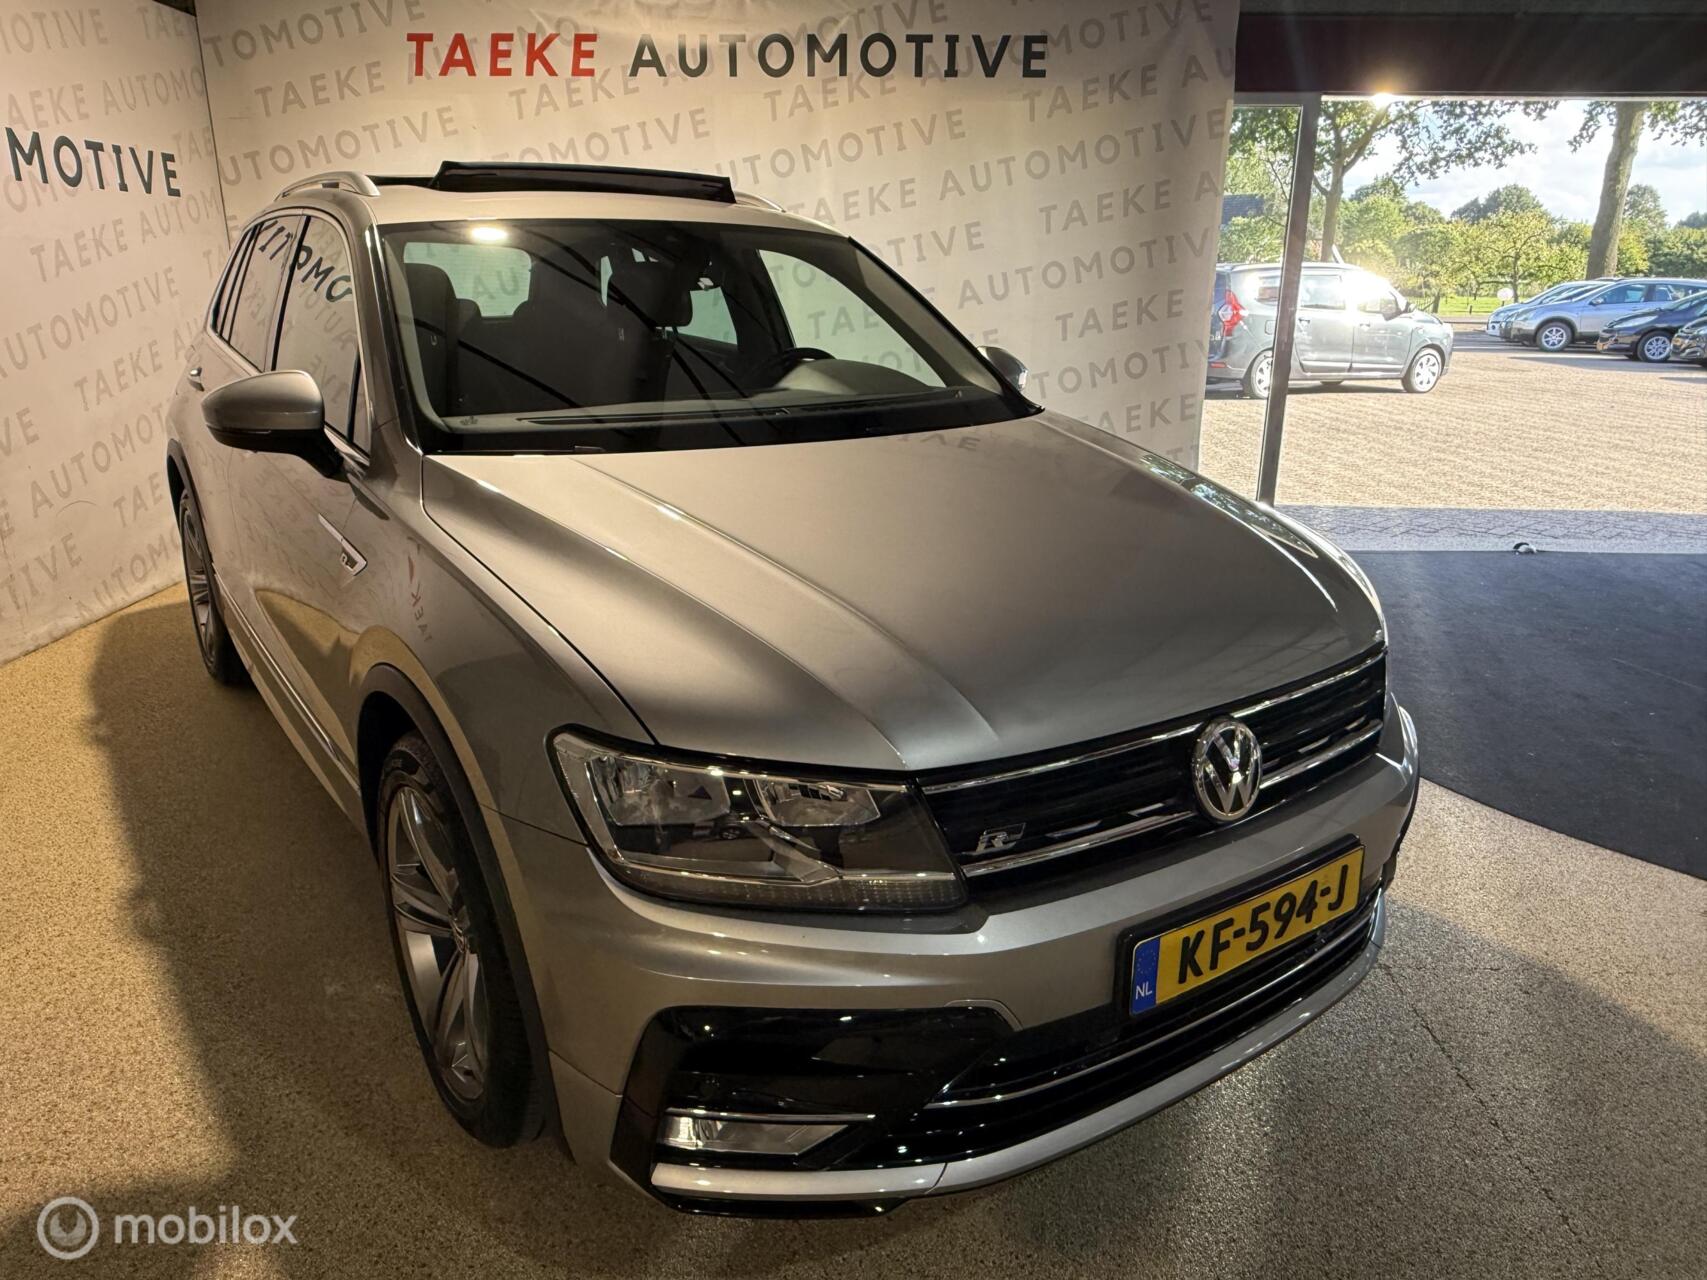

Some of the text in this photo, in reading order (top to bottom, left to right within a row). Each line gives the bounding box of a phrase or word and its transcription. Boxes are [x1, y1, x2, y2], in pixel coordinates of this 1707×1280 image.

[407, 32, 1048, 78] TAEKE AUTOMOTIVE
[254, 60, 385, 118] TAEKE
[1022, 63, 1158, 122] TAEKE
[5, 127, 181, 197] MOTIVE
[938, 108, 1226, 201] AUTOMOTIVE
[1038, 179, 1172, 235] TAEKE
[29, 217, 129, 283] TAEKE
[1055, 288, 1185, 342] TAEKE
[73, 339, 163, 412] TAEKE
[1178, 864, 1349, 985] KF-594-J
[1135, 979, 1154, 1000] NL
